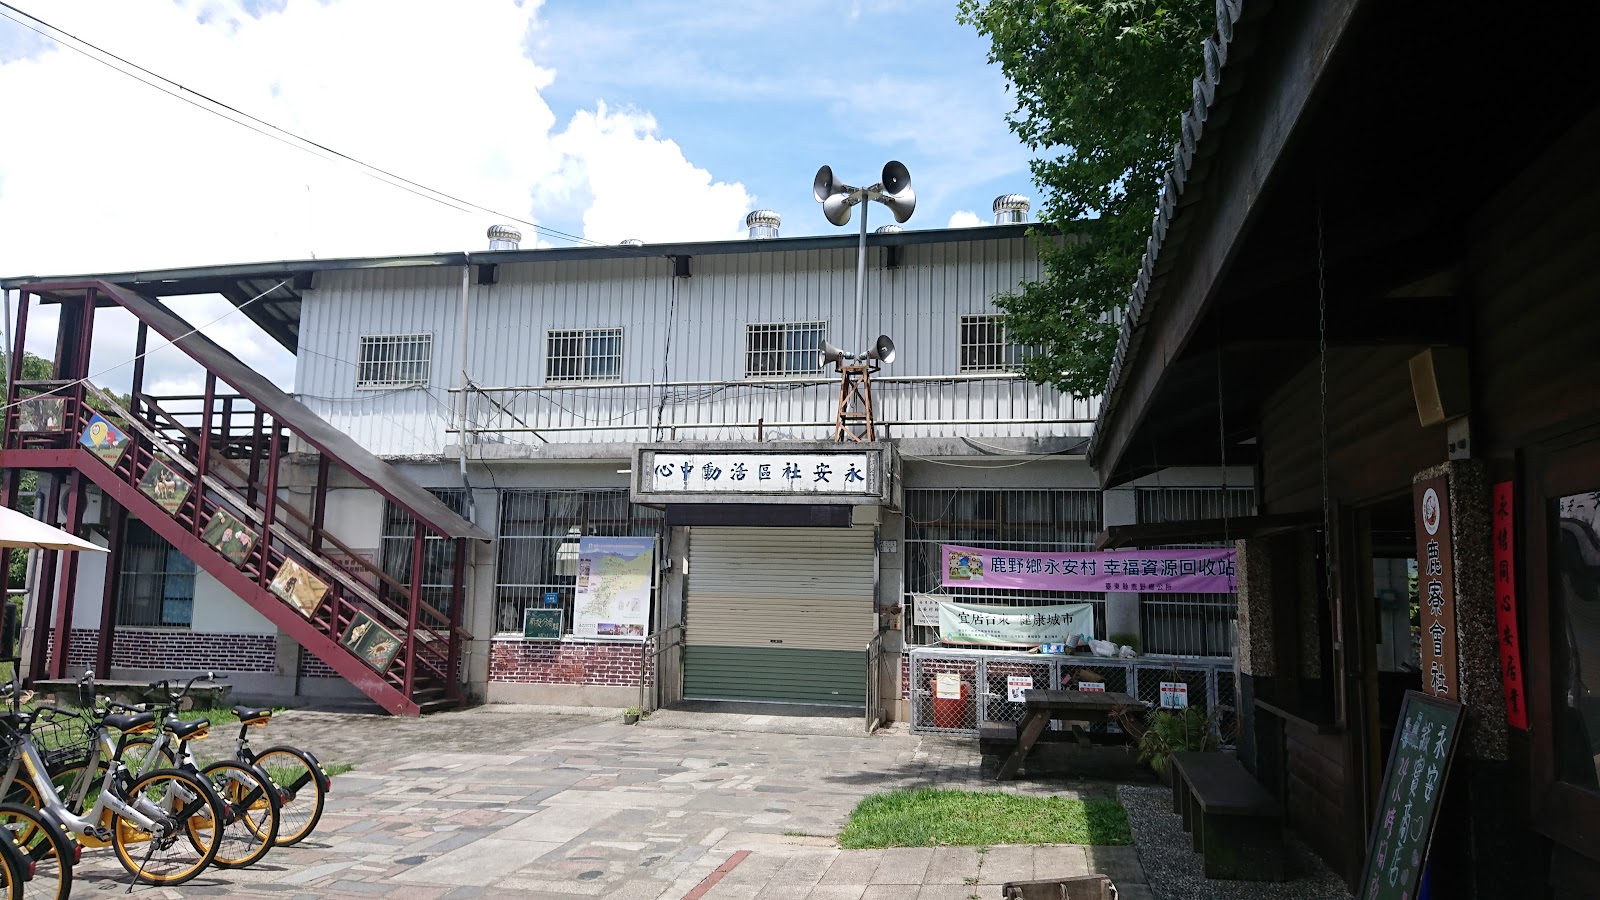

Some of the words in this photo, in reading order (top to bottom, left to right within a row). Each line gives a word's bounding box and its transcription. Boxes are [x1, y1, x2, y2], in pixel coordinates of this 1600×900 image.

[654, 461, 865, 483] 永安社區活動中心
[990, 556, 1097, 576] 鹿野鄉永安村
[1103, 558, 1236, 578] 幸福資源回收站
[1019, 612, 1074, 628] 健康城市
[1425, 538, 1449, 698] 鹿寮會社
[1424, 723, 1447, 803] 永安
